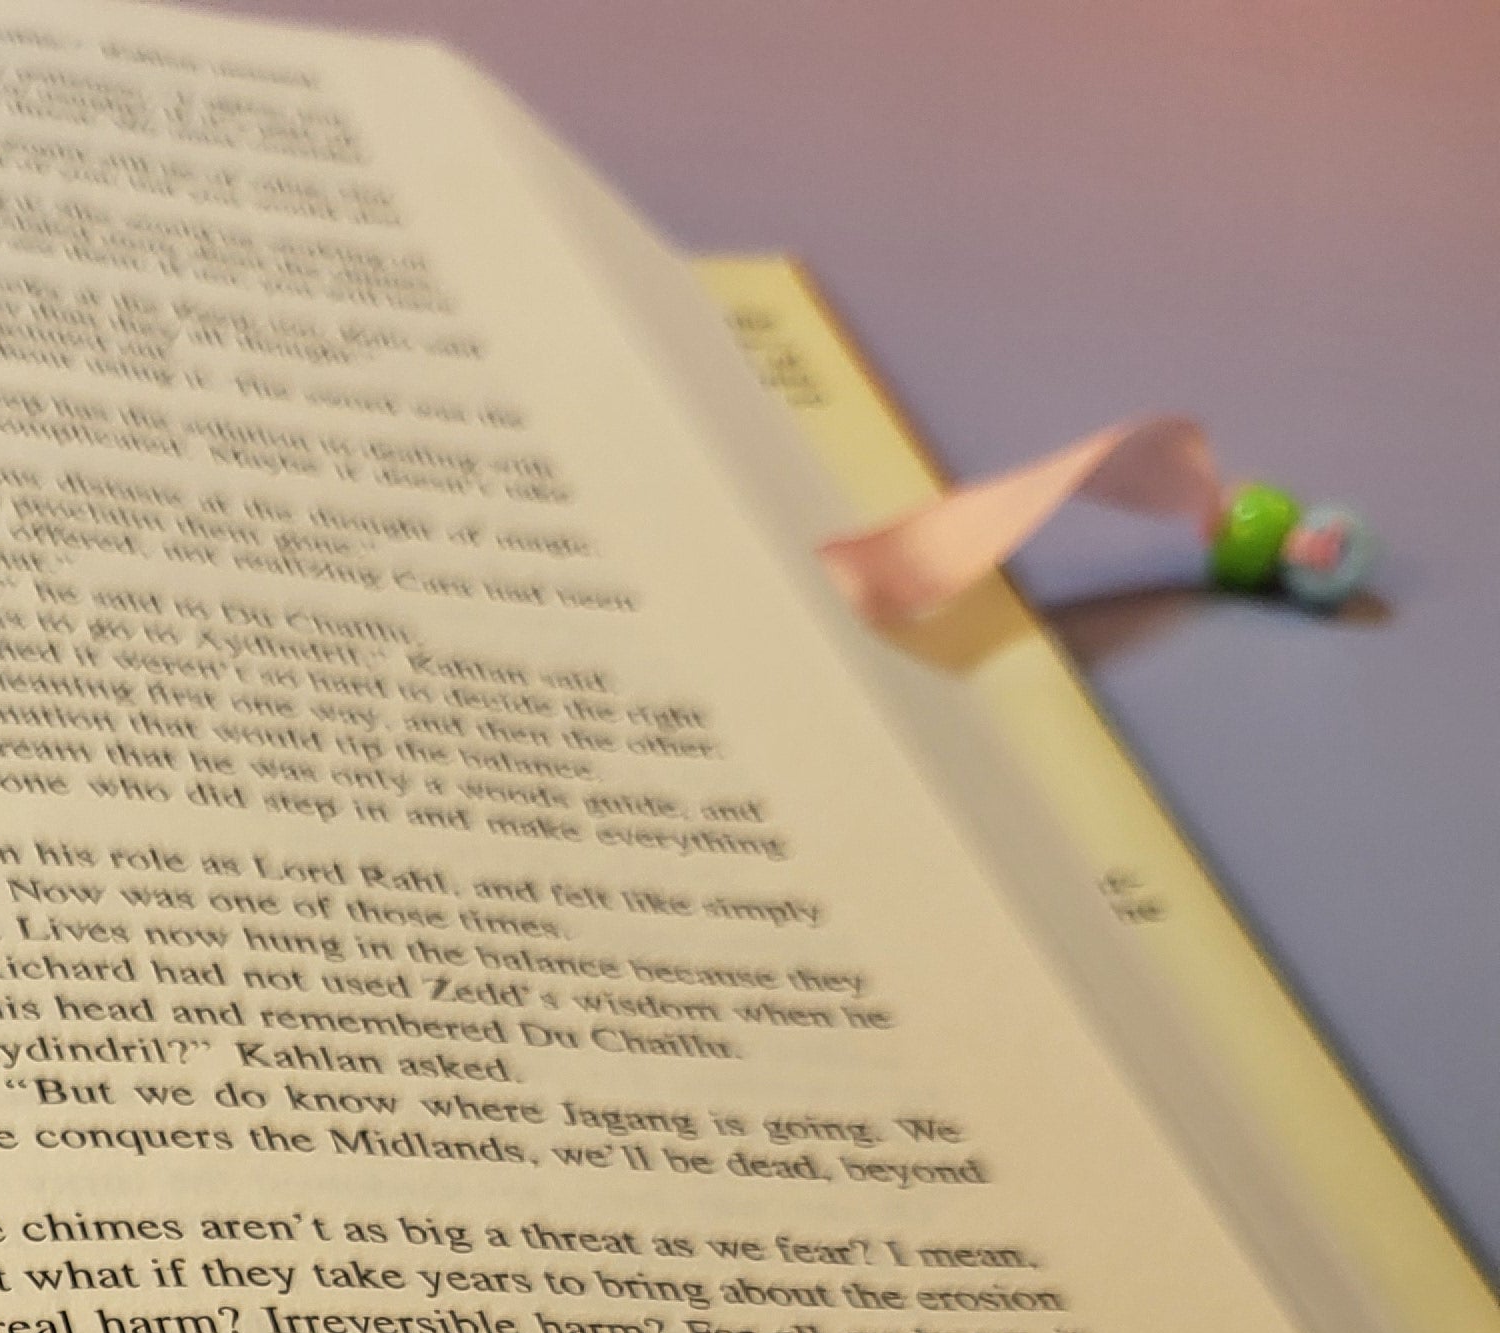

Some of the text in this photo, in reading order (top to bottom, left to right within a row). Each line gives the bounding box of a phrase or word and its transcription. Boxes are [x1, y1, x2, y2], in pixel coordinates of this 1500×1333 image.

[33, 841, 96, 867] his
[5, 1077, 113, 1105] “But
[133, 1085, 195, 1106] we
[215, 1080, 267, 1108] do
[284, 1083, 398, 1114] know
[421, 1093, 545, 1125] where
[560, 1100, 699, 1141] Jagang
[713, 1110, 747, 1137] is
[893, 1115, 962, 1144] We
[35, 1127, 234, 1156] conquers
[248, 1124, 315, 1153] the
[327, 1127, 541, 1167] Midlands,
[550, 1143, 654, 1171] we’ll
[661, 1147, 715, 1175] be
[839, 1155, 992, 1190] beyond
[21, 1211, 184, 1243] chimes
[200, 1213, 331, 1242] aren’t
[343, 1222, 389, 1243] as
[396, 1215, 473, 1254] big
[485, 1227, 511, 1248] a
[519, 1221, 643, 1255] threat
[651, 1237, 695, 1258] as
[705, 1239, 766, 1262] we
[883, 1239, 910, 1267] I
[23, 1259, 141, 1291] what
[151, 1257, 187, 1288] if
[201, 1257, 296, 1295] they
[312, 1259, 406, 1290] take
[416, 1270, 533, 1299] years
[543, 1271, 587, 1296] to
[593, 1270, 713, 1311] bring
[719, 1277, 836, 1308] about
[841, 1281, 907, 1310] the
[916, 1283, 1067, 1311] erosion
